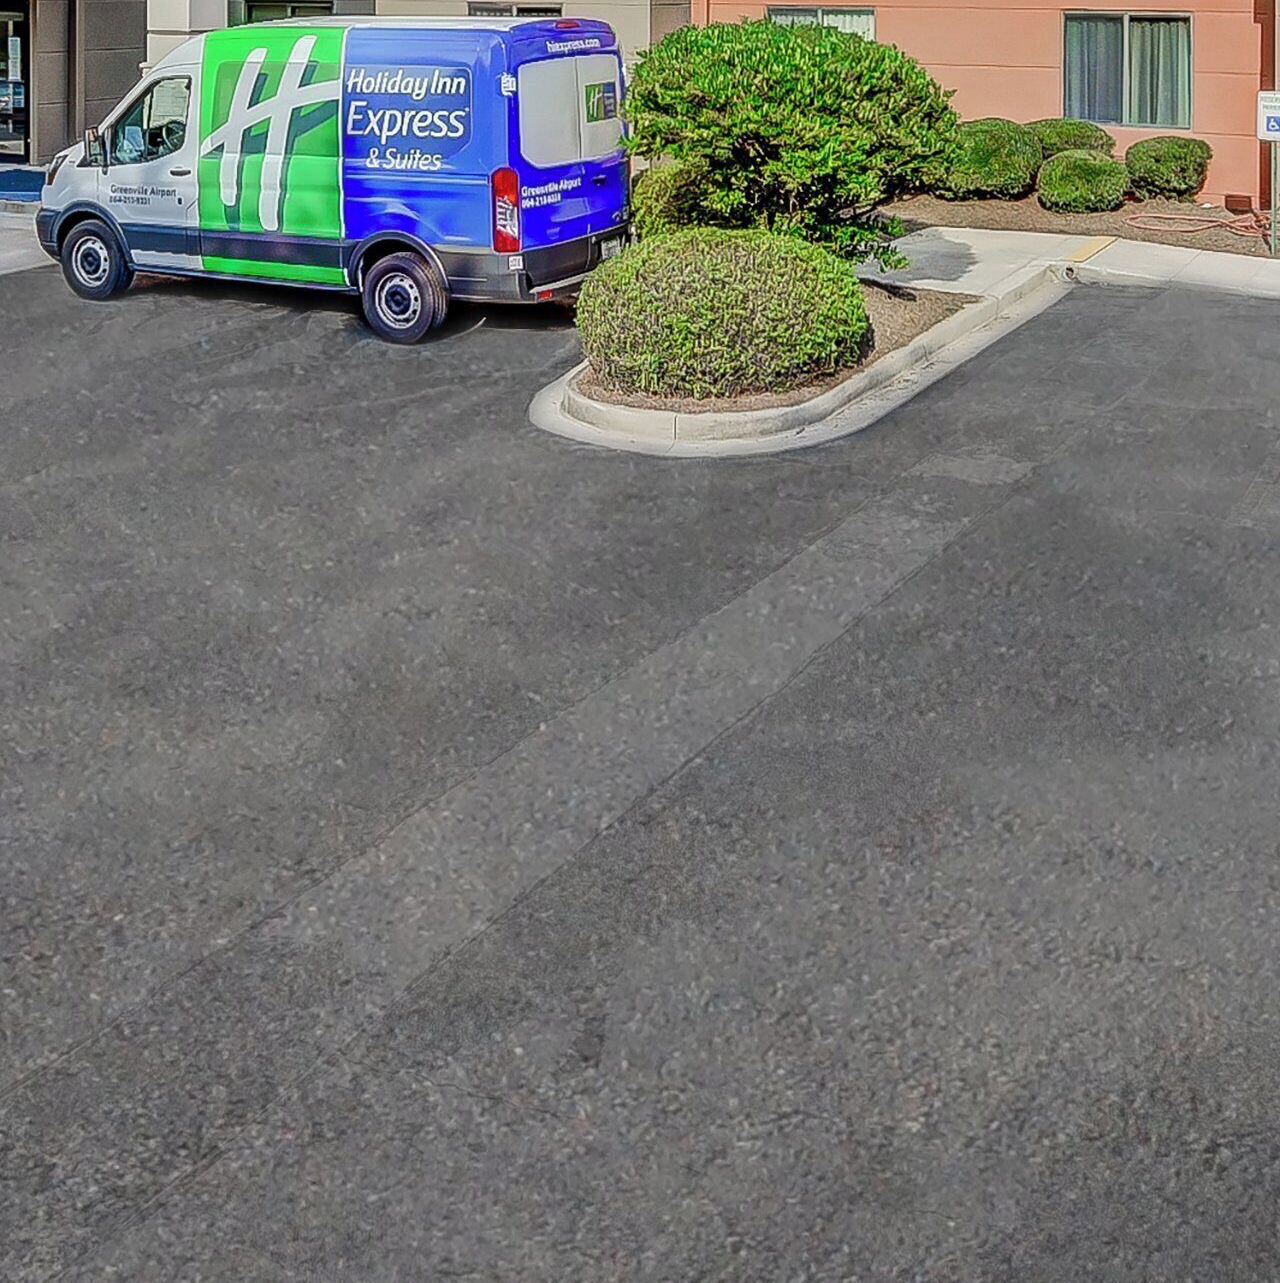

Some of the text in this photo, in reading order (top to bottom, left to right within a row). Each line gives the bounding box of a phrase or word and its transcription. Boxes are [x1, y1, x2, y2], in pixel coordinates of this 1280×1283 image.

[546, 38, 601, 53] hiexpress.com
[347, 68, 466, 101] Holiday Inn
[347, 101, 466, 145] Express
[365, 147, 442, 171] & Suites
[110, 184, 177, 198] Greenville Airport
